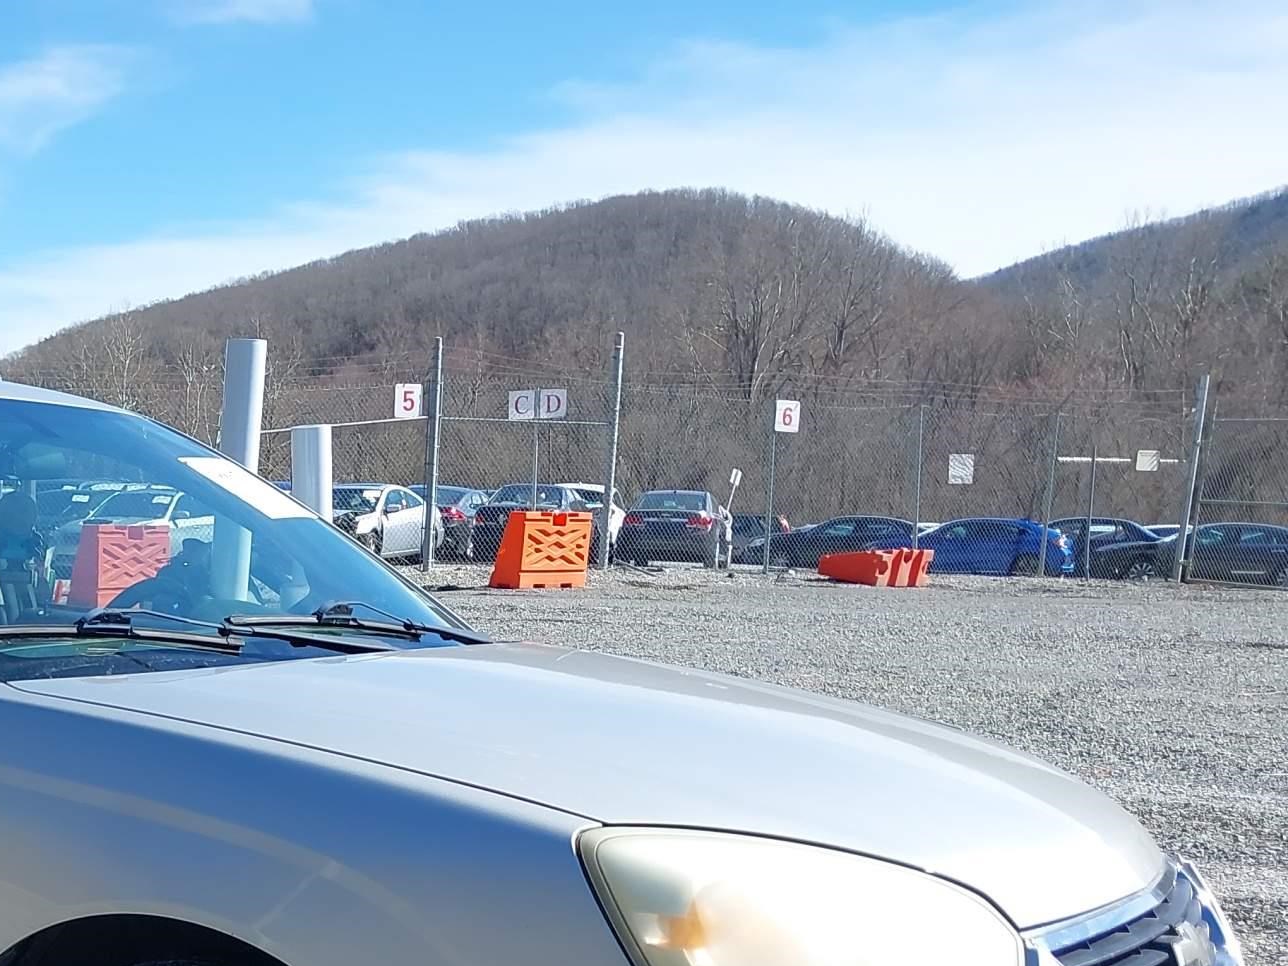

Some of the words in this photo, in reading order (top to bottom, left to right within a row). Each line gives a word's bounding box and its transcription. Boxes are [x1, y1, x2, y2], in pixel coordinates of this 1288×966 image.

[402, 390, 415, 412] 5
[514, 395, 529, 415] C
[545, 394, 561, 414] D
[782, 407, 793, 426] 6
